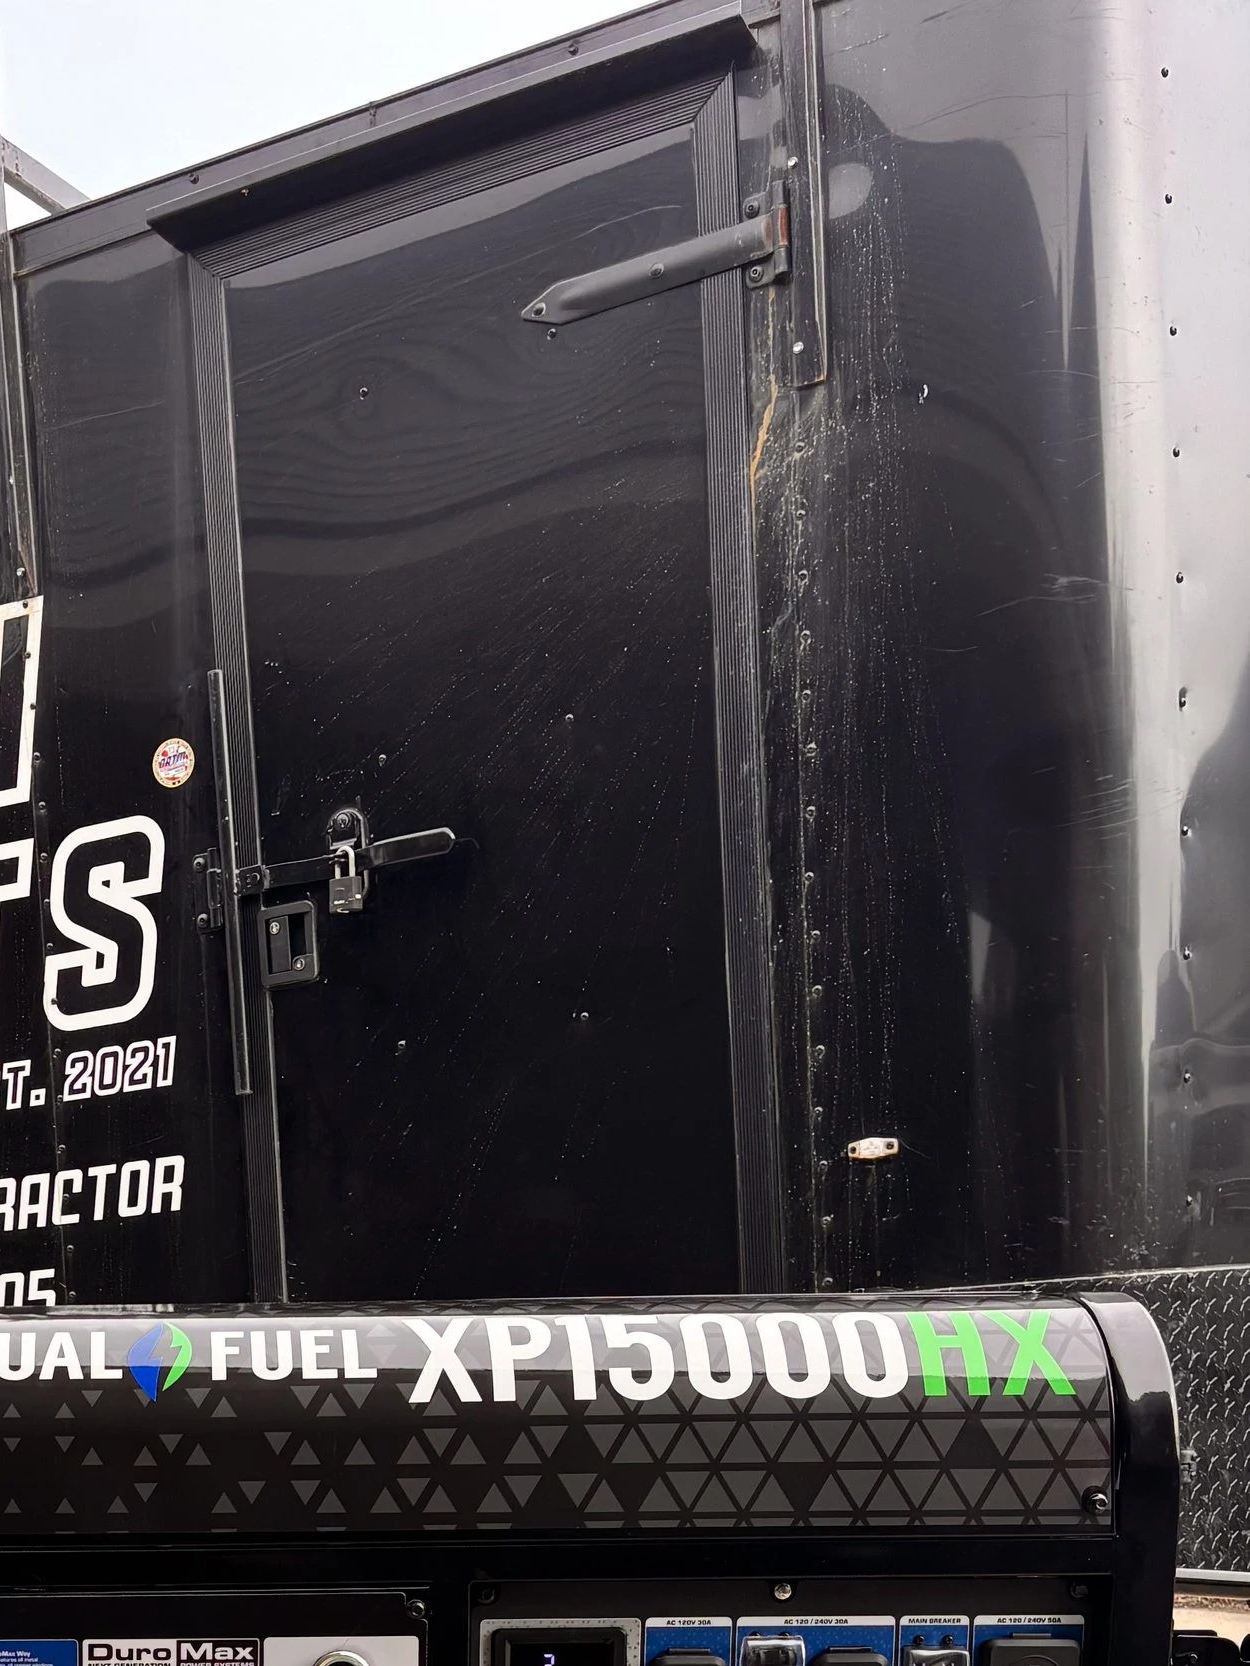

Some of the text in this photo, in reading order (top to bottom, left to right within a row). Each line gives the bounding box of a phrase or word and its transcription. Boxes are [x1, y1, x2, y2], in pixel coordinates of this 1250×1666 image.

[63, 1035, 175, 1101] 2021
[209, 1329, 378, 1381] FUEL
[401, 1310, 1077, 1404] XP15000HX
[87, 1642, 254, 1661] Duro Max
